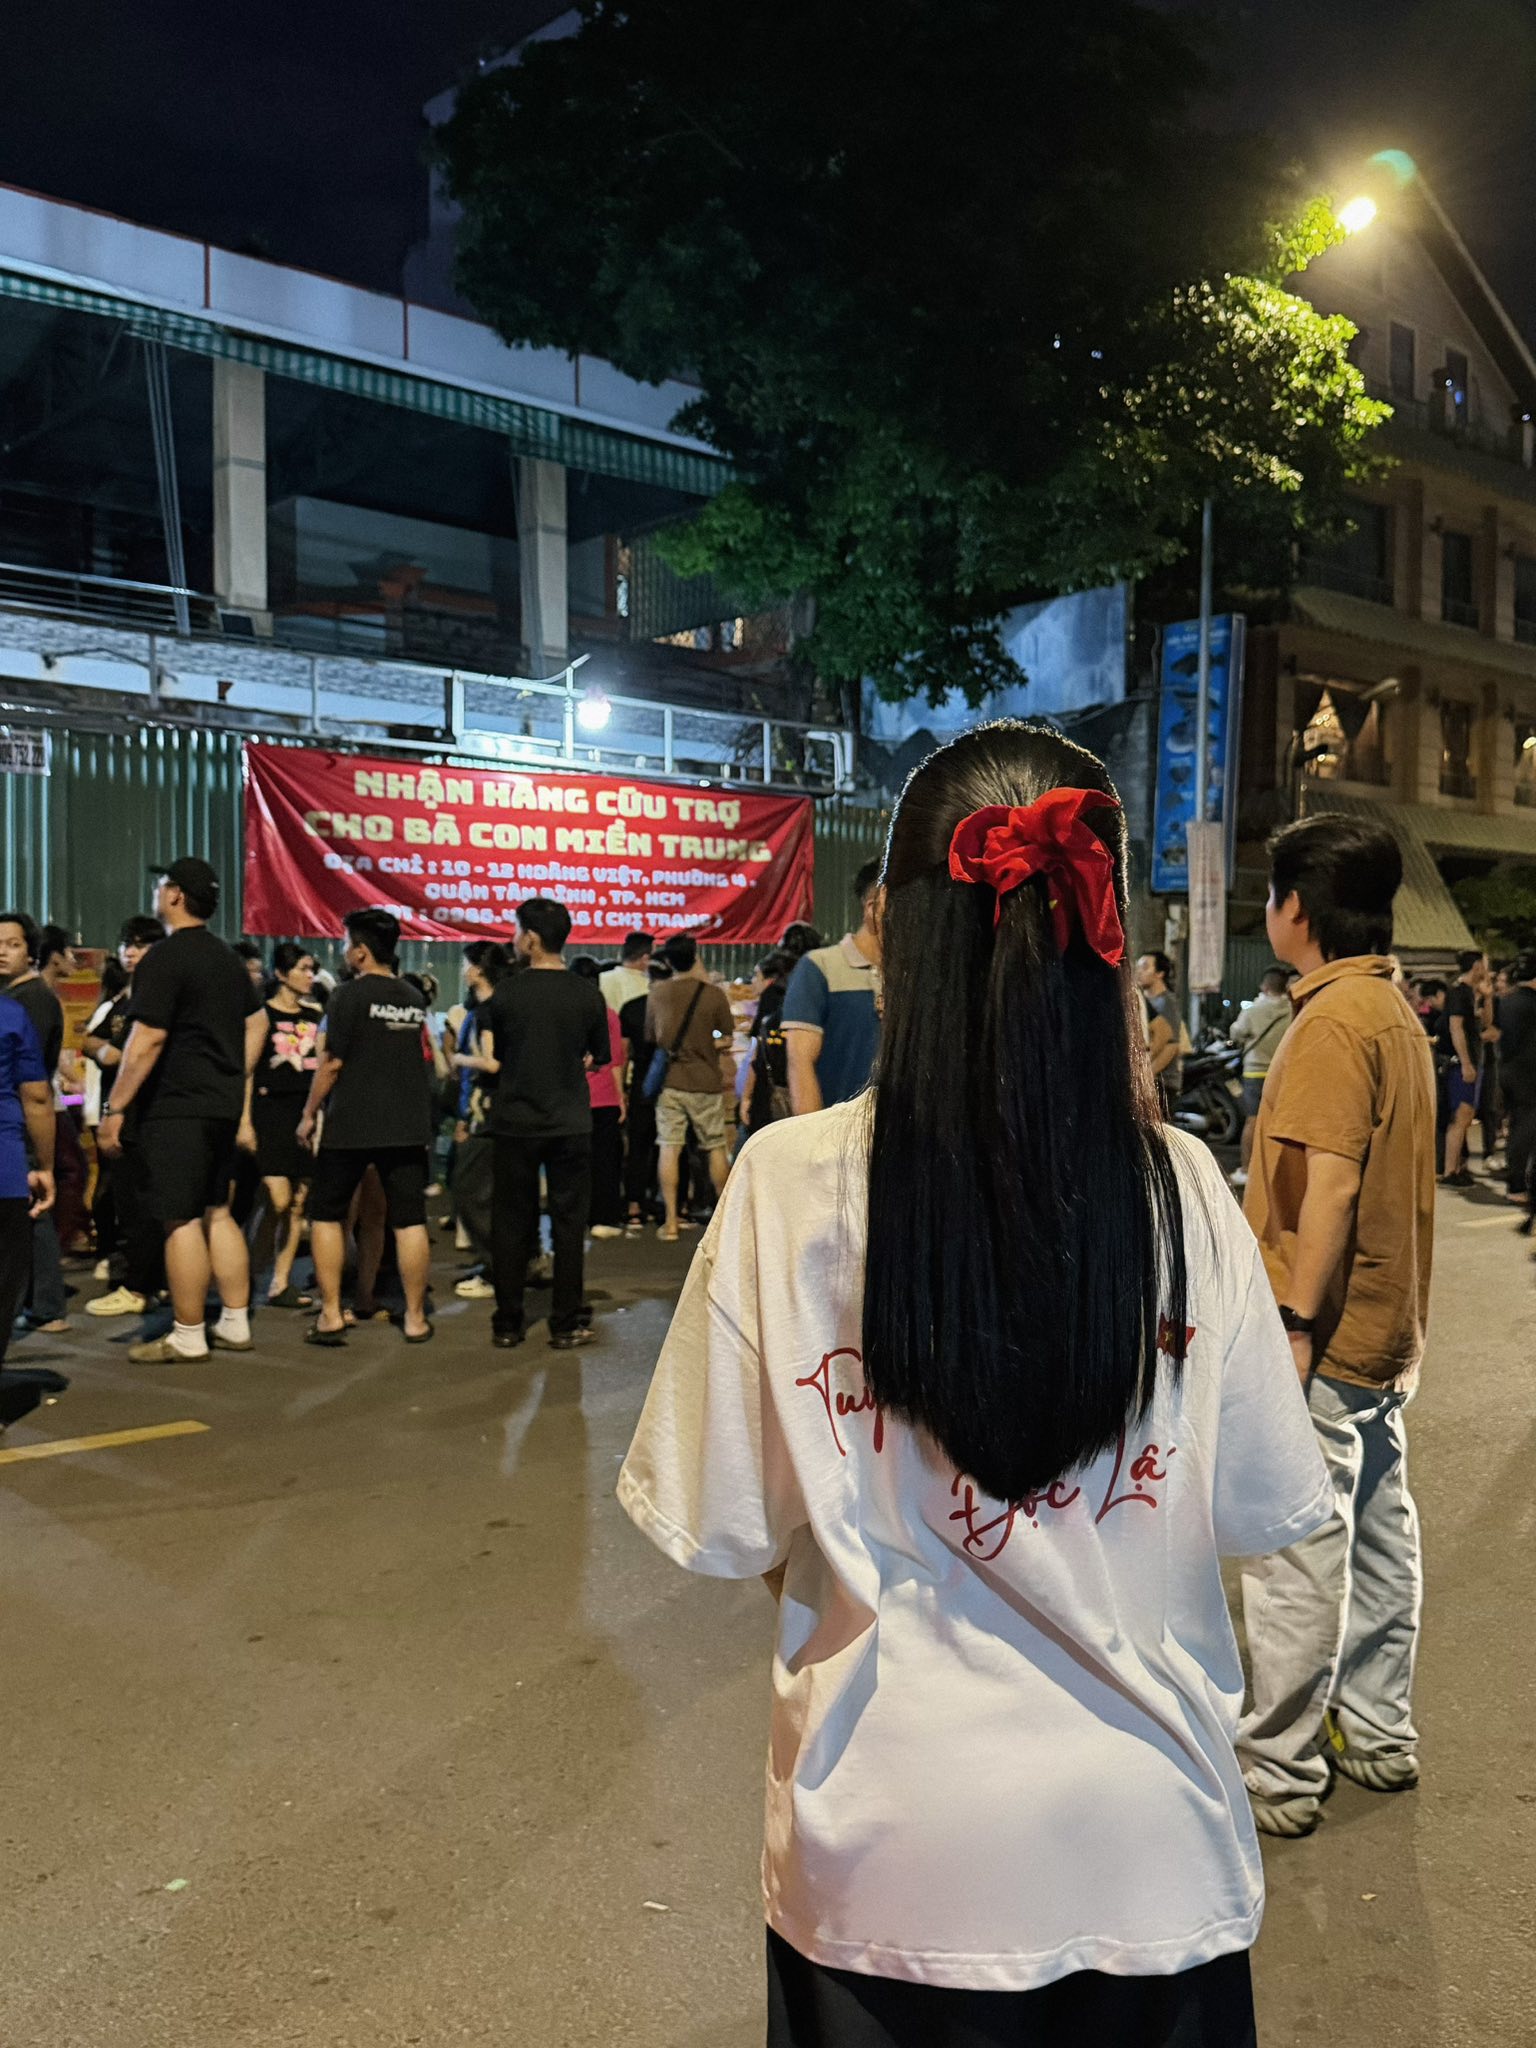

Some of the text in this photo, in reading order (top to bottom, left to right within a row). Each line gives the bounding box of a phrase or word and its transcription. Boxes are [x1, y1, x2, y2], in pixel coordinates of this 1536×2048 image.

[354, 768, 741, 831] NHẬN HÀNG CỨU TRỢ
[304, 810, 772, 862] CHO BÀ CON MIỀN TRUNG
[425, 880, 489, 904] QUẬN
[645, 891, 686, 907] HCM
